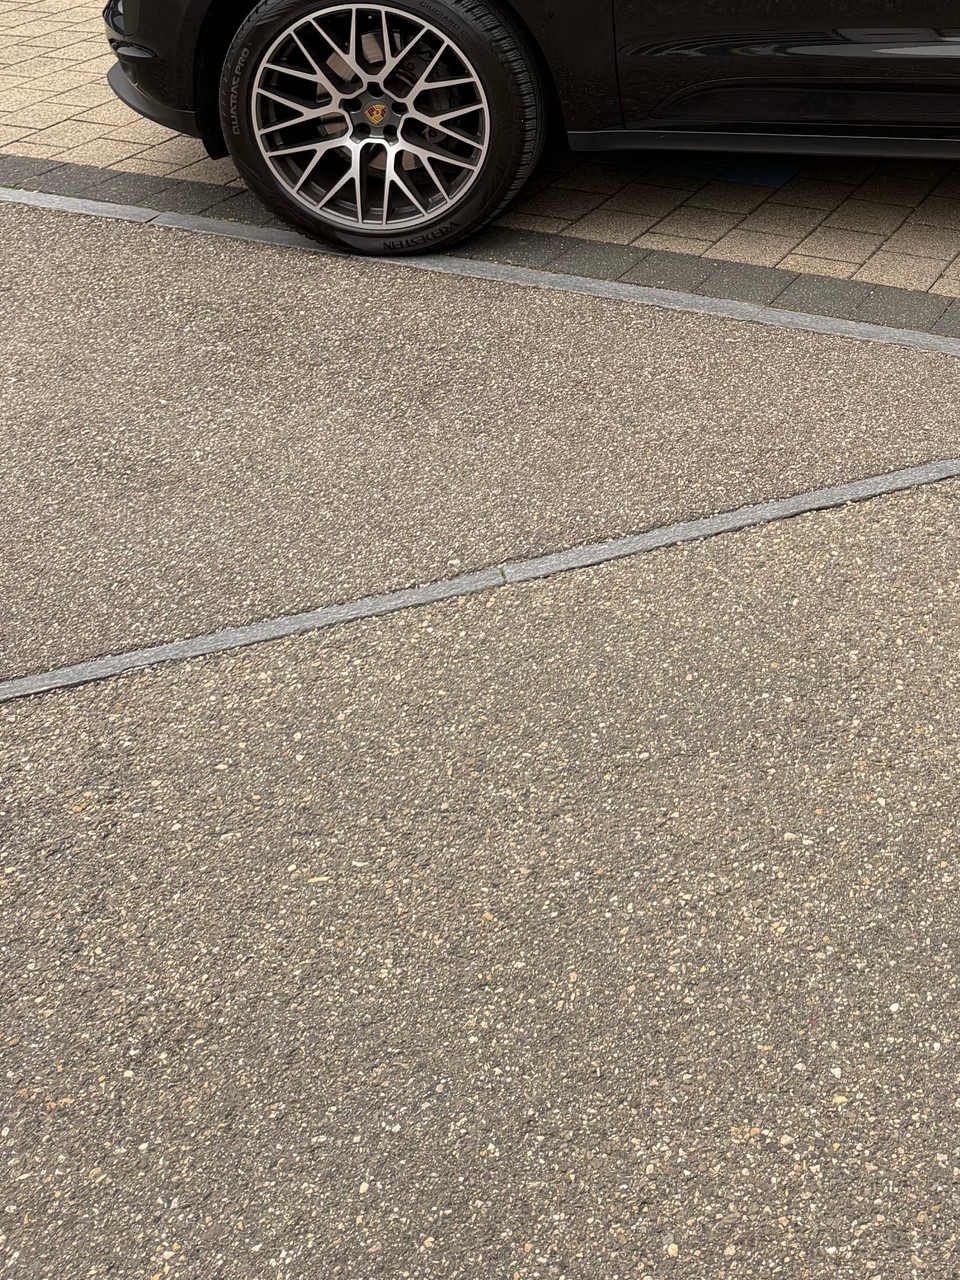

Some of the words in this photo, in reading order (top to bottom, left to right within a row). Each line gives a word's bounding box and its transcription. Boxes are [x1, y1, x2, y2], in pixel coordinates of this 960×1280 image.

[420, 1, 460, 30] GIUGIARO
[230, 76, 240, 135] QUATRAC
[235, 47, 250, 76] PRO
[382, 221, 460, 250] VREDESTEIN
